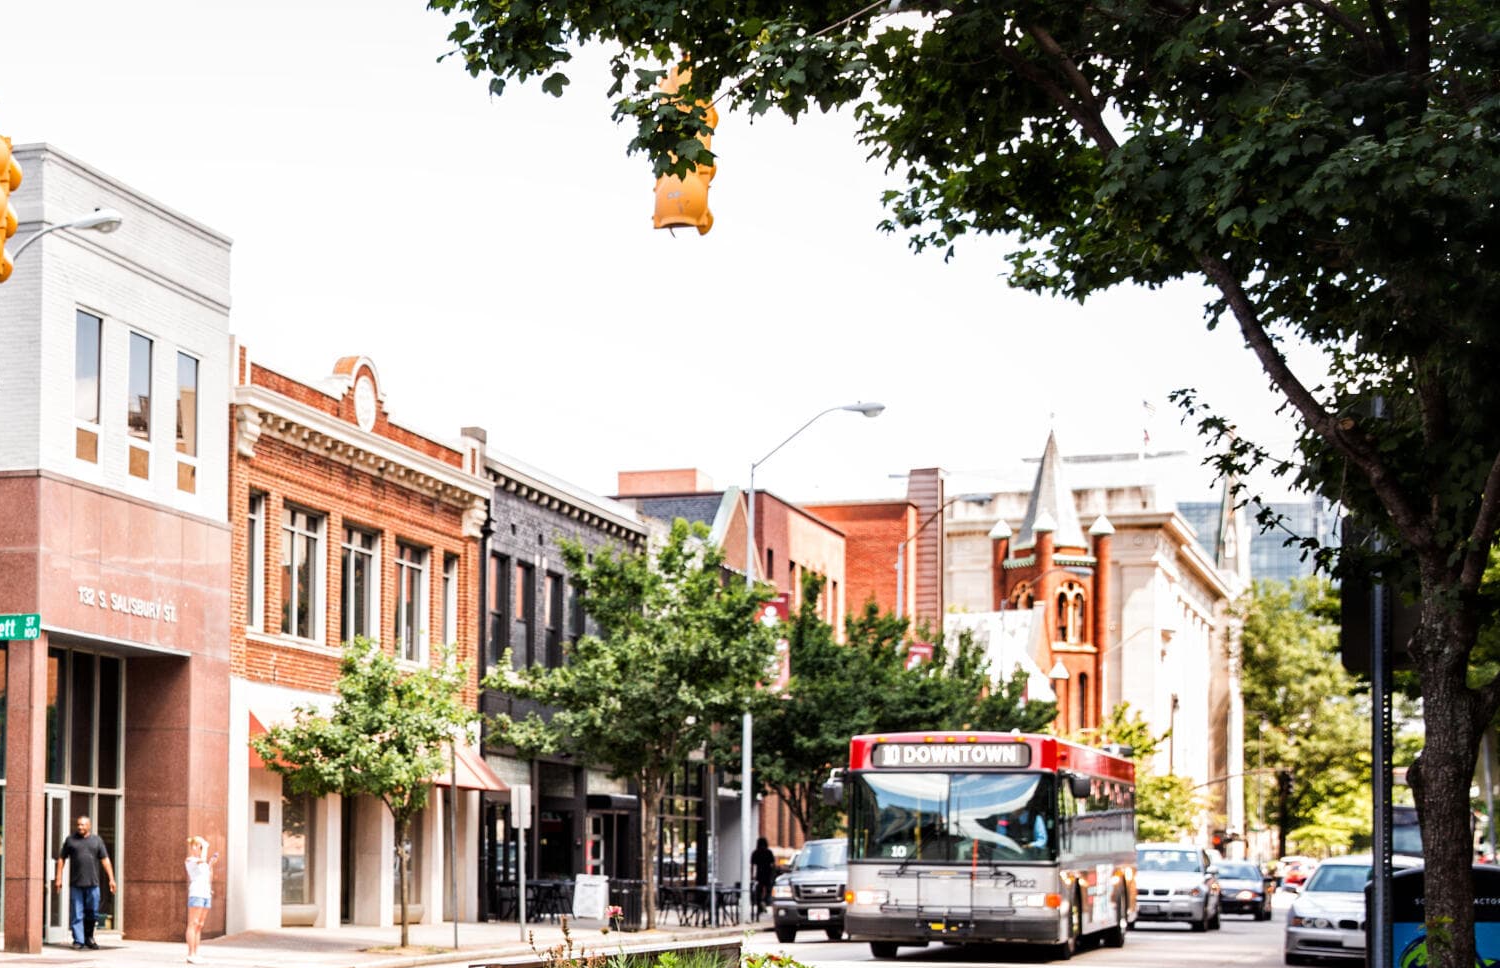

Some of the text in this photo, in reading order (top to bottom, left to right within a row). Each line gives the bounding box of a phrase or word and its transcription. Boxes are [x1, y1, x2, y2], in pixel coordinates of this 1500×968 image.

[78, 586, 95, 606] 132
[110, 592, 161, 620] SALISBURY
[25, 616, 36, 627] ST
[24, 628, 38, 638] 100
[903, 745, 1017, 763] DOWNTOWN
[891, 845, 907, 857] 10
